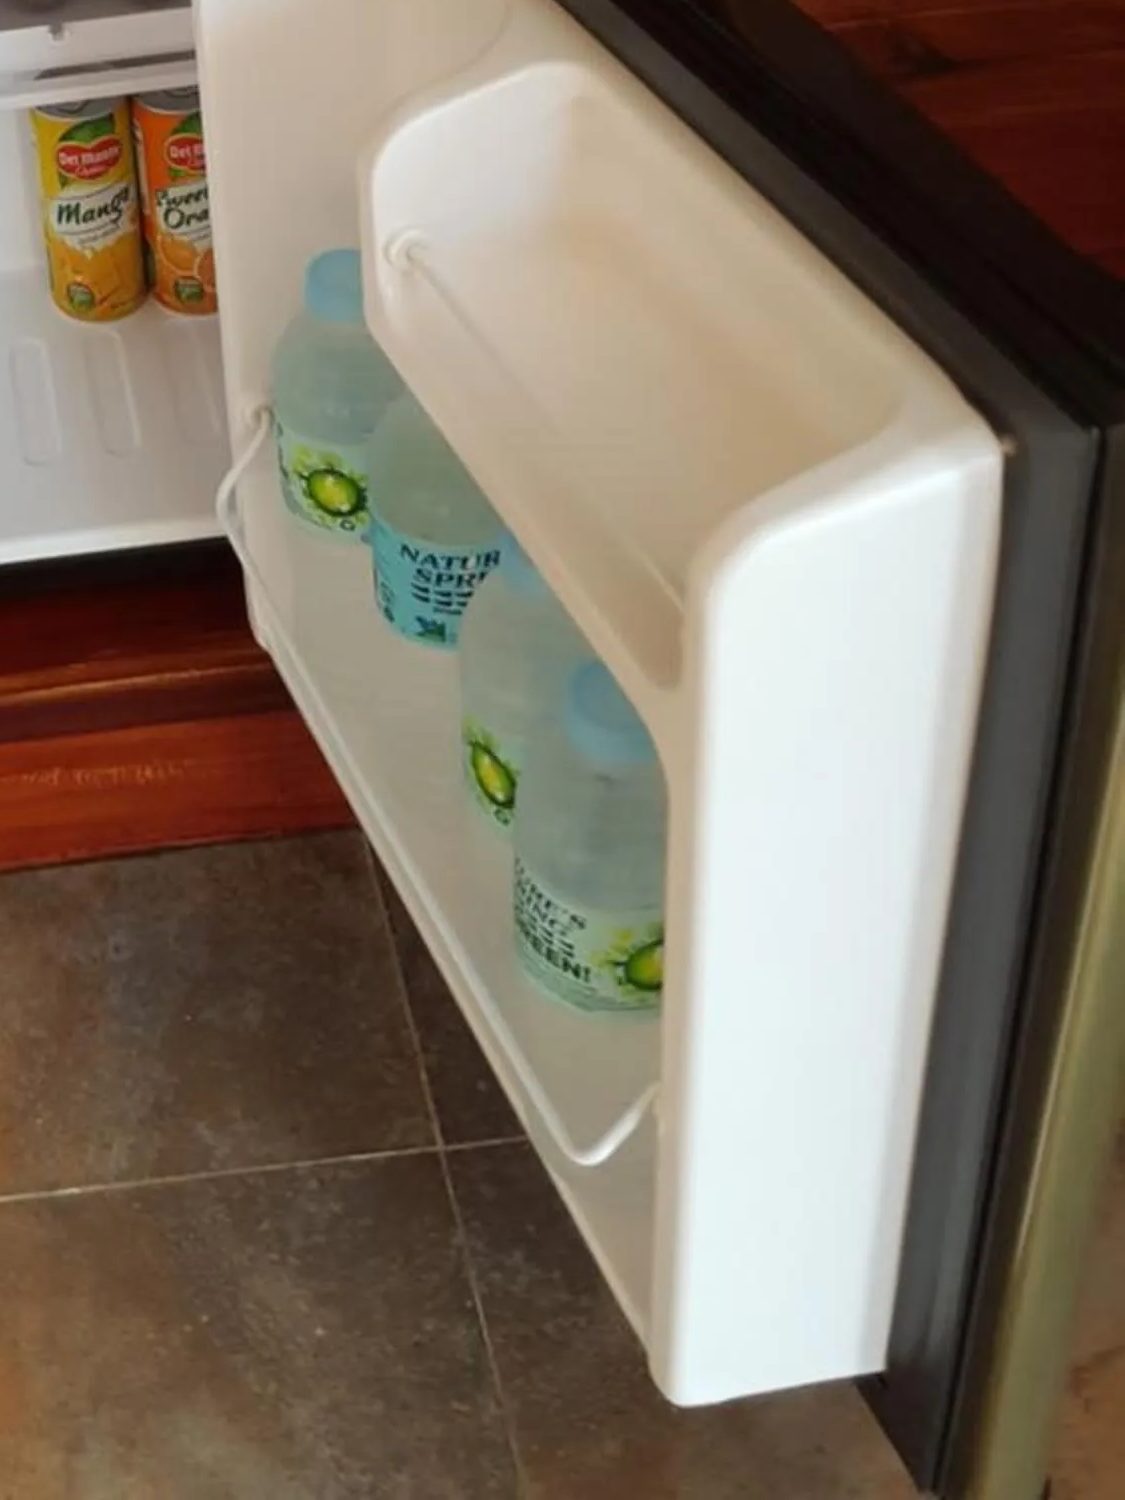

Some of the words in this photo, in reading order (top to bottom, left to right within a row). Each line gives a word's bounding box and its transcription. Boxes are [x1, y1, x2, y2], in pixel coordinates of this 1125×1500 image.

[57, 186, 130, 225] Mango
[163, 207, 209, 230] Ora
[400, 544, 500, 569] NATUR
